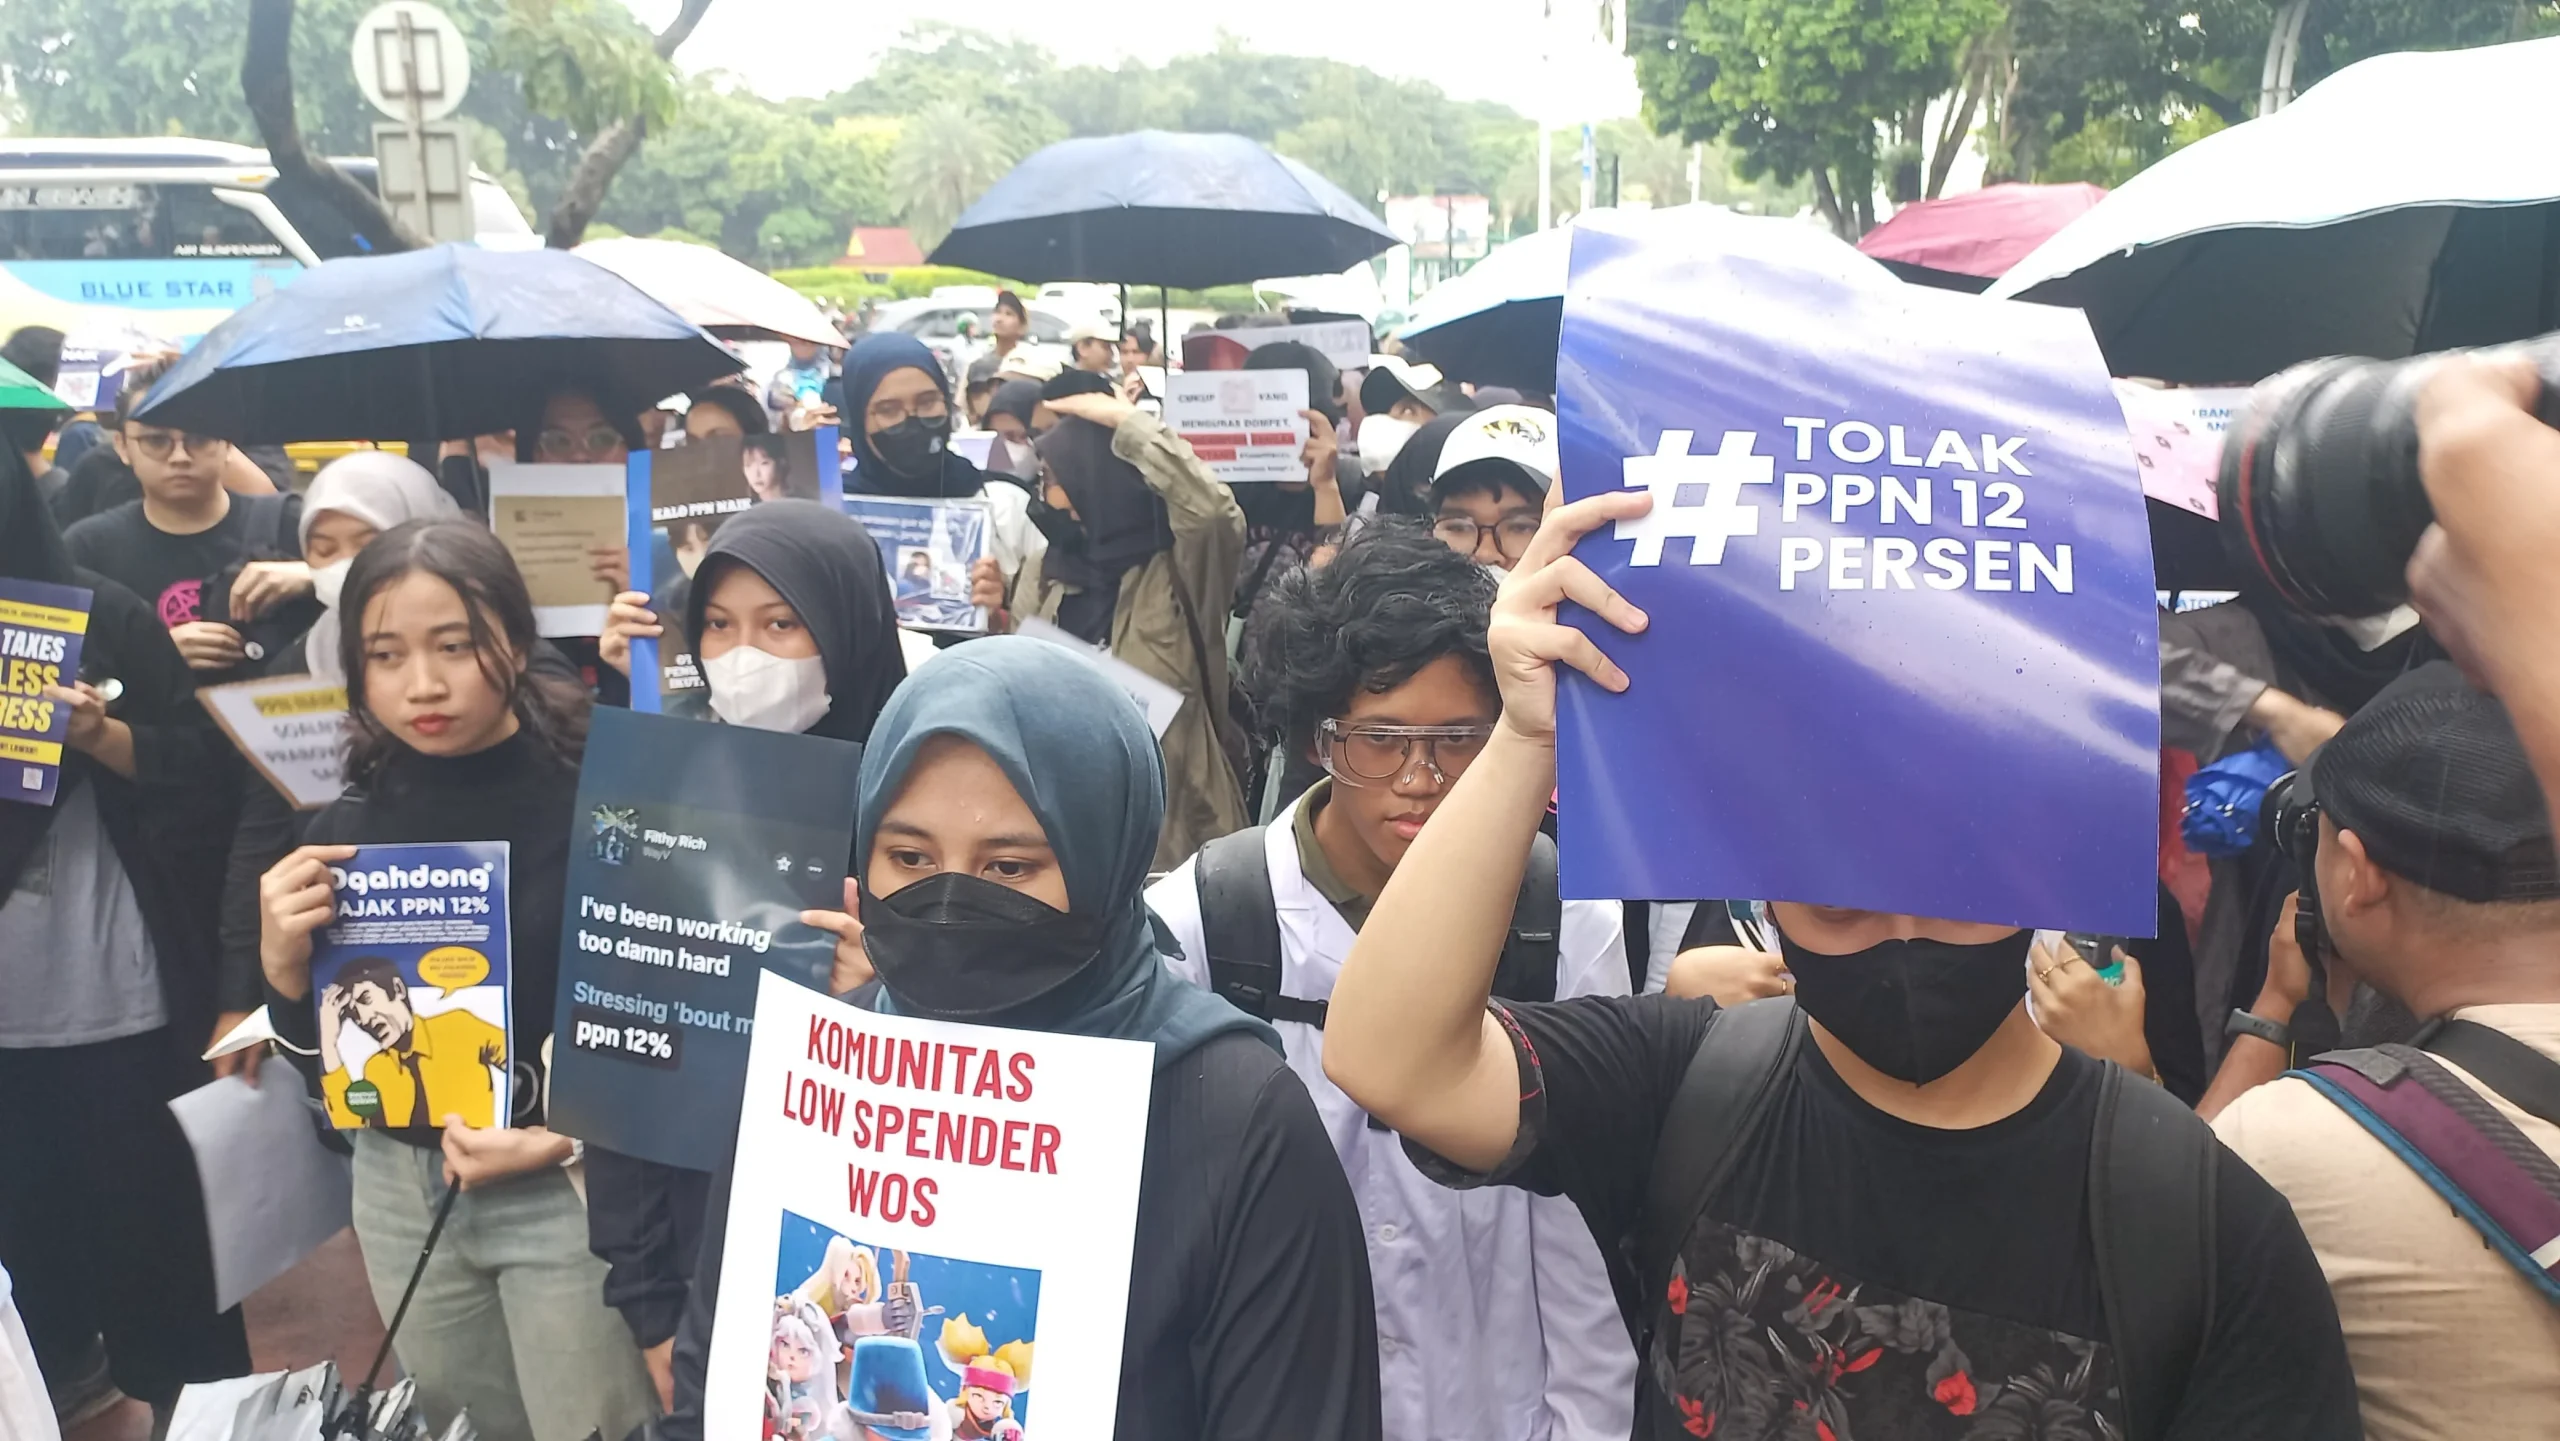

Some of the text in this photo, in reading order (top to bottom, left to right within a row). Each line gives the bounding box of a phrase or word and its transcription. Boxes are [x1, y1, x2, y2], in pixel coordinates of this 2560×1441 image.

[81, 281, 234, 299] BLUE STAR
[1258, 393, 1289, 402] YANG
[1181, 418, 1241, 428] MENGURAS
[1782, 416, 2033, 476] TOLAK
[652, 505, 688, 522] KALO
[689, 502, 716, 517] PPN
[1613, 429, 1774, 567] #
[1781, 472, 2029, 529] PPN 12
[1779, 536, 2074, 594] PERSEN
[3, 628, 67, 664] TAXES
[643, 829, 708, 851] Filthy Rich
[401, 897, 446, 915] PPN
[449, 896, 490, 915] 12%
[580, 895, 773, 953] I've been working
[578, 929, 731, 977] too damn hard
[573, 981, 668, 1024] Stressing
[673, 1001, 731, 1032] 'bout
[575, 1020, 673, 1059] ppn 12%
[807, 1013, 1036, 1103] KOMUNITAS
[783, 1070, 1062, 1175] LOW SPENDER
[848, 1162, 939, 1228] WOS
